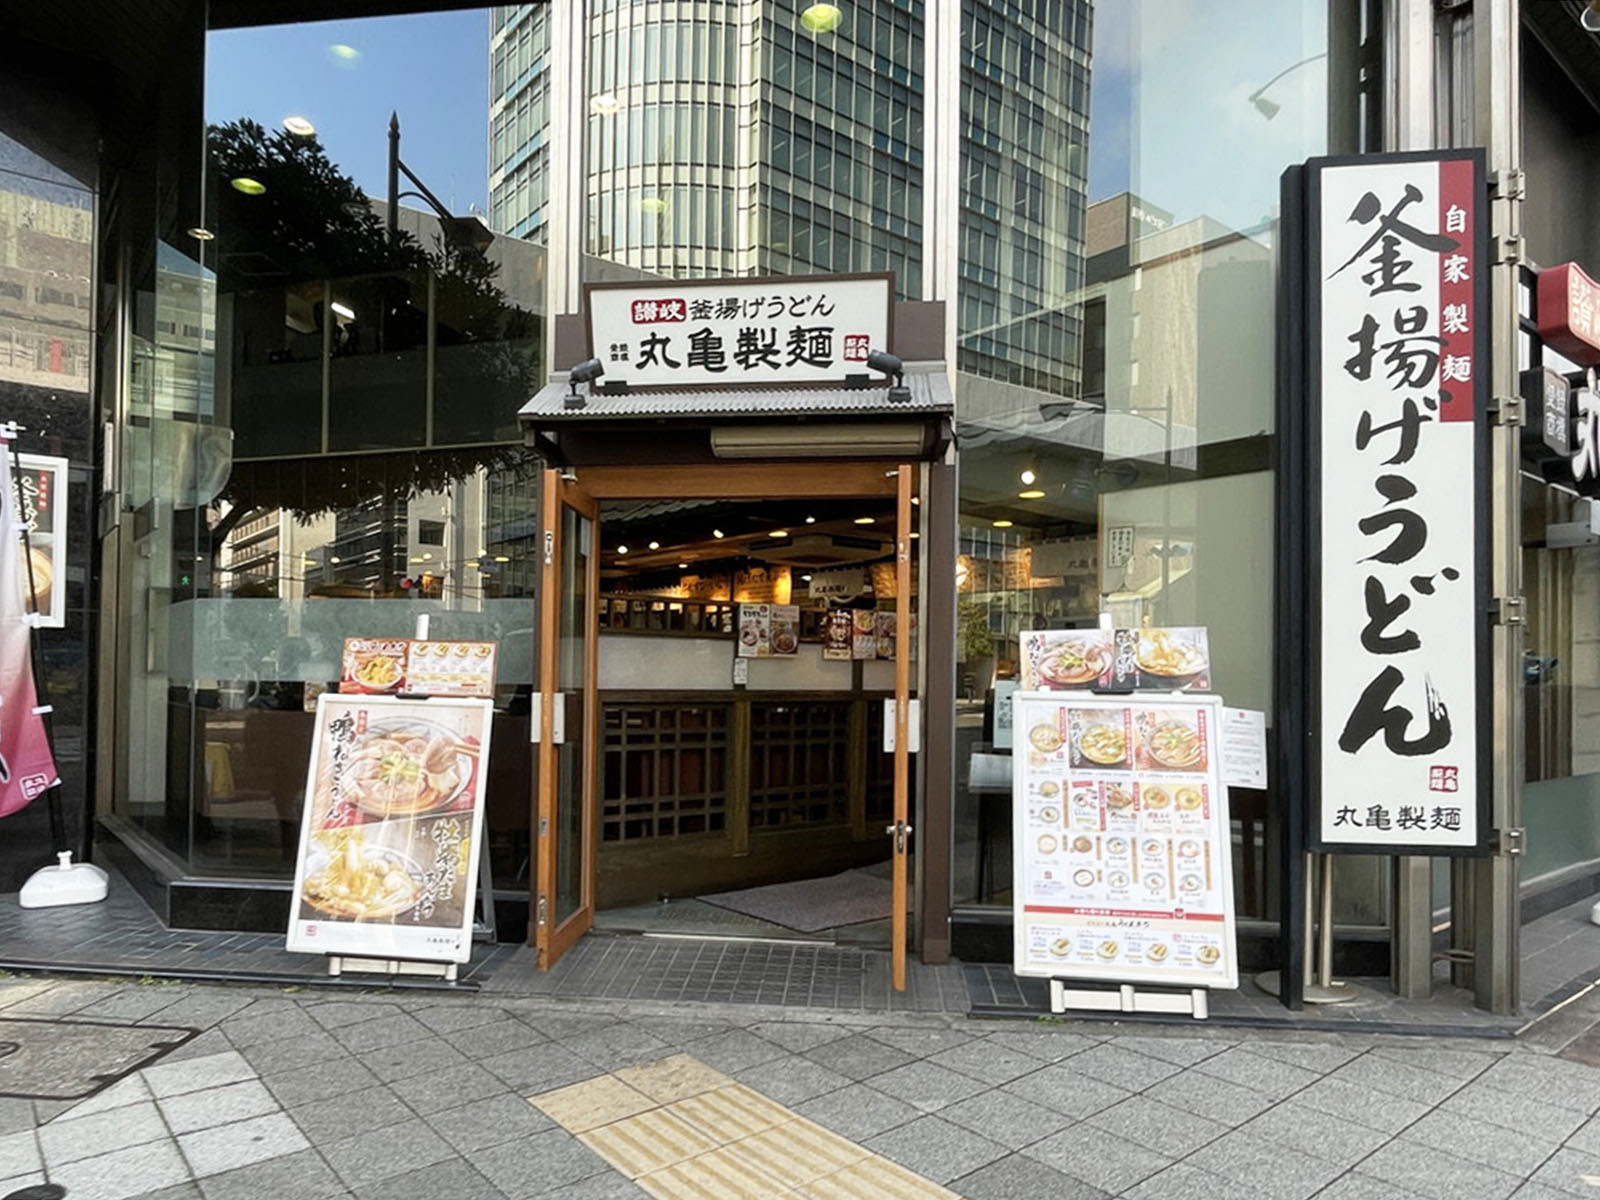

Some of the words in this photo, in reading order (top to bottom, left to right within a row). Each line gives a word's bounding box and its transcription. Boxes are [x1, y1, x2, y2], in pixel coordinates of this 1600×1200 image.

[633, 300, 685, 322] 讃岐
[689, 294, 835, 321] 釜揚げうどん
[1442, 205, 1471, 383] 自家製麺
[635, 325, 835, 372] 丸亀製麺
[1326, 184, 1460, 756] 釜揚げうどん
[1333, 804, 1461, 831] 丸亀製麺
